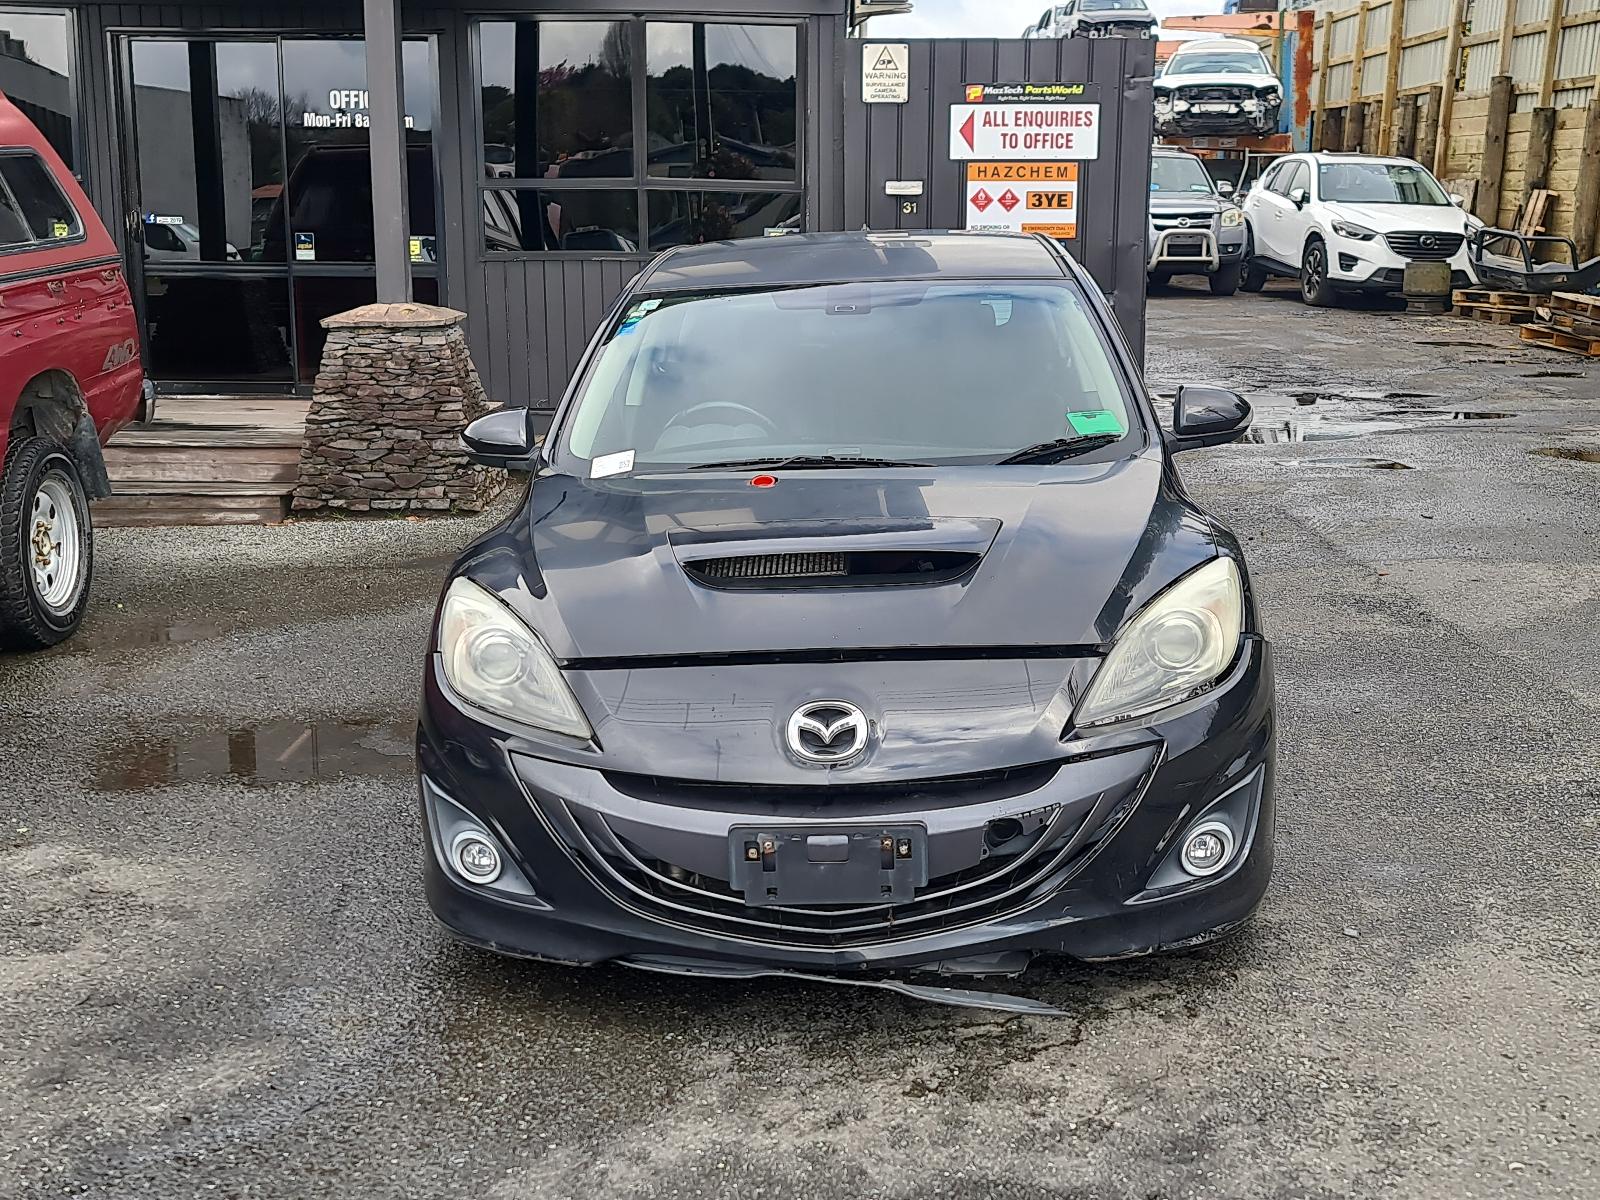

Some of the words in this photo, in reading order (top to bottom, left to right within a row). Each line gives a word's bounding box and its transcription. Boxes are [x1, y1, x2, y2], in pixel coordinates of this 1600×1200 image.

[983, 85, 1024, 94] MazTech
[1025, 84, 1084, 94] PartsWorld
[329, 90, 369, 109] OFFI
[303, 112, 351, 128] Mon-Fri
[982, 111, 1009, 127] ALL
[1014, 111, 1093, 128] ENQUIRIES
[1000, 133, 1018, 149] TO
[1023, 133, 1074, 149] OFFICE
[977, 166, 1068, 178] HAZCHEM
[902, 202, 917, 214] 31
[1031, 193, 1068, 208] 3YE
